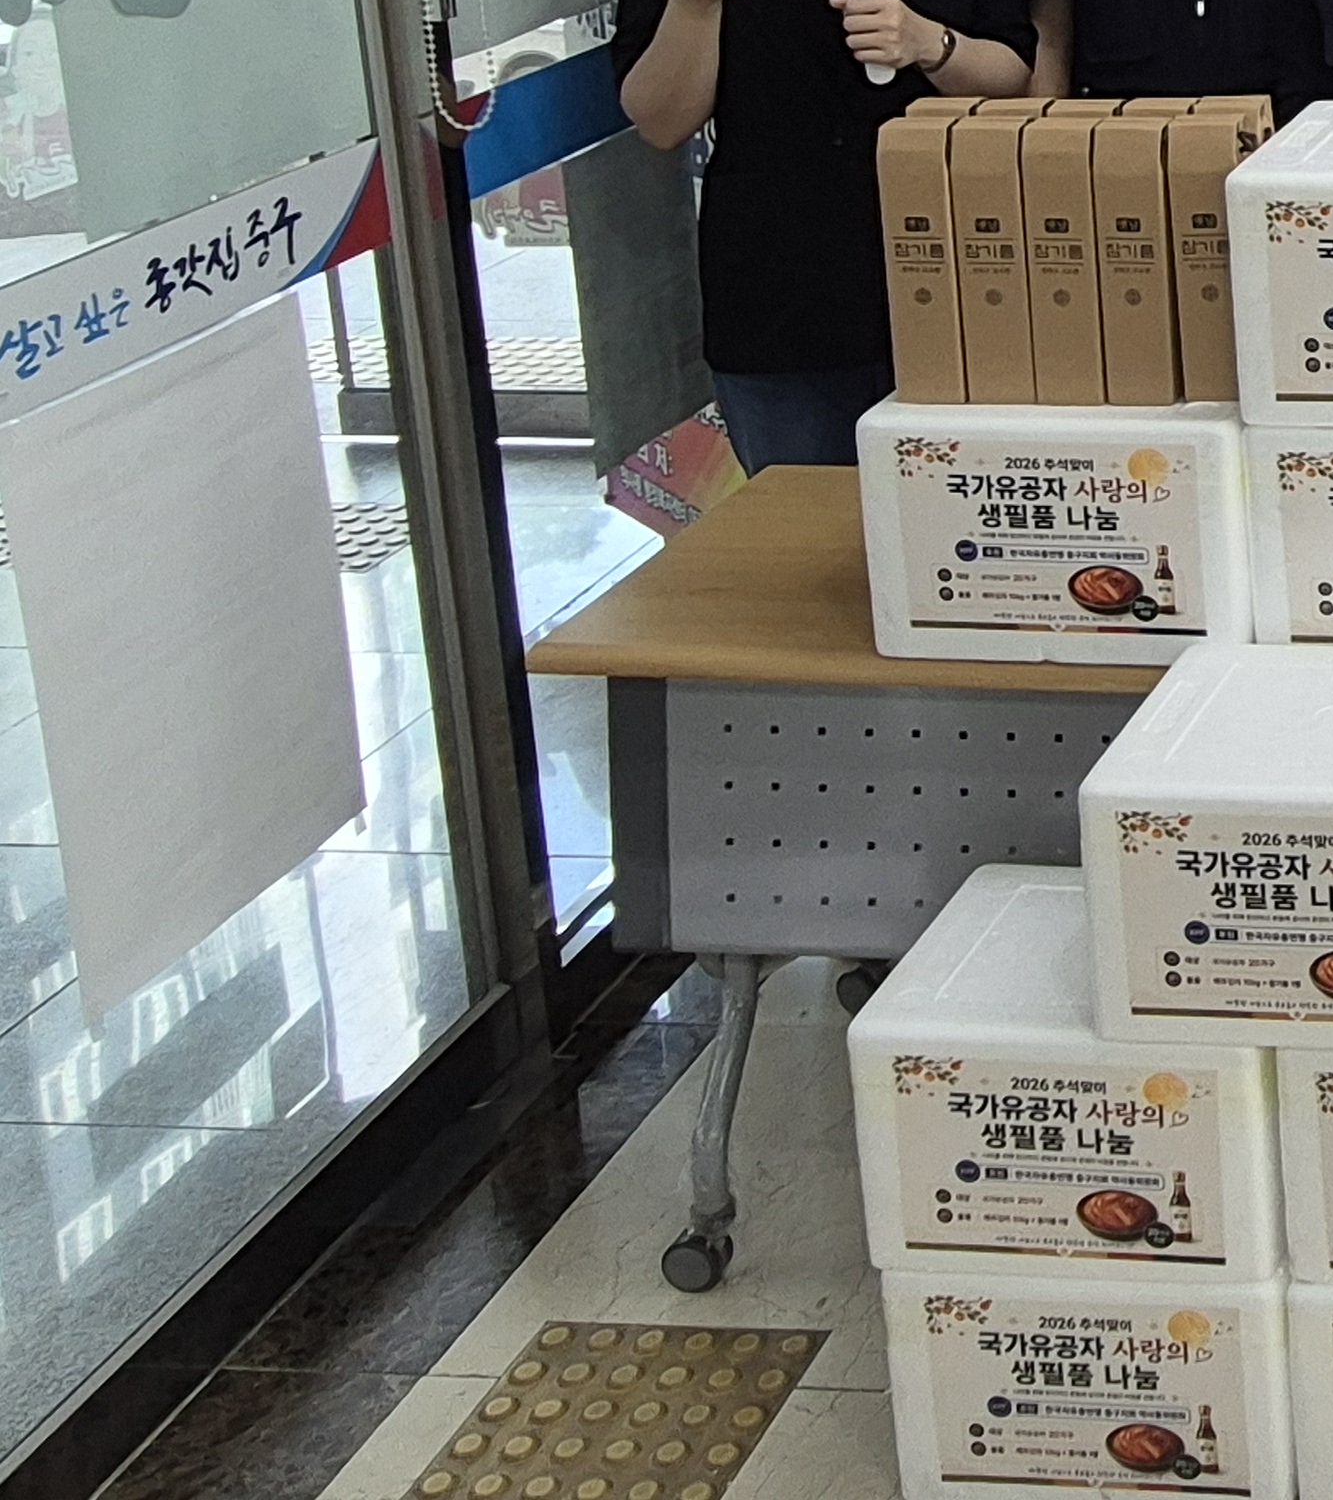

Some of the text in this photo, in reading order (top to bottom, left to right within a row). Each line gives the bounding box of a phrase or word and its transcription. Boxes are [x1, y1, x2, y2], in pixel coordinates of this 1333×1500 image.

[0, 195, 303, 381] 살고 싶은 종갓집 중구
[945, 474, 1147, 504] 국가유공자 사랑의
[977, 503, 1120, 531] 생필품 나눔
[1241, 832, 1282, 847] 2026
[1175, 850, 1312, 881] 국가유공자
[1210, 881, 1299, 911] 생필품
[947, 1092, 1164, 1129] 국가유공자 사랑의
[980, 1123, 1135, 1156] 생필품 나눔
[977, 1331, 1189, 1365] 국가유공자 사랑의
[1011, 1360, 1160, 1391] 생필품 나눔
